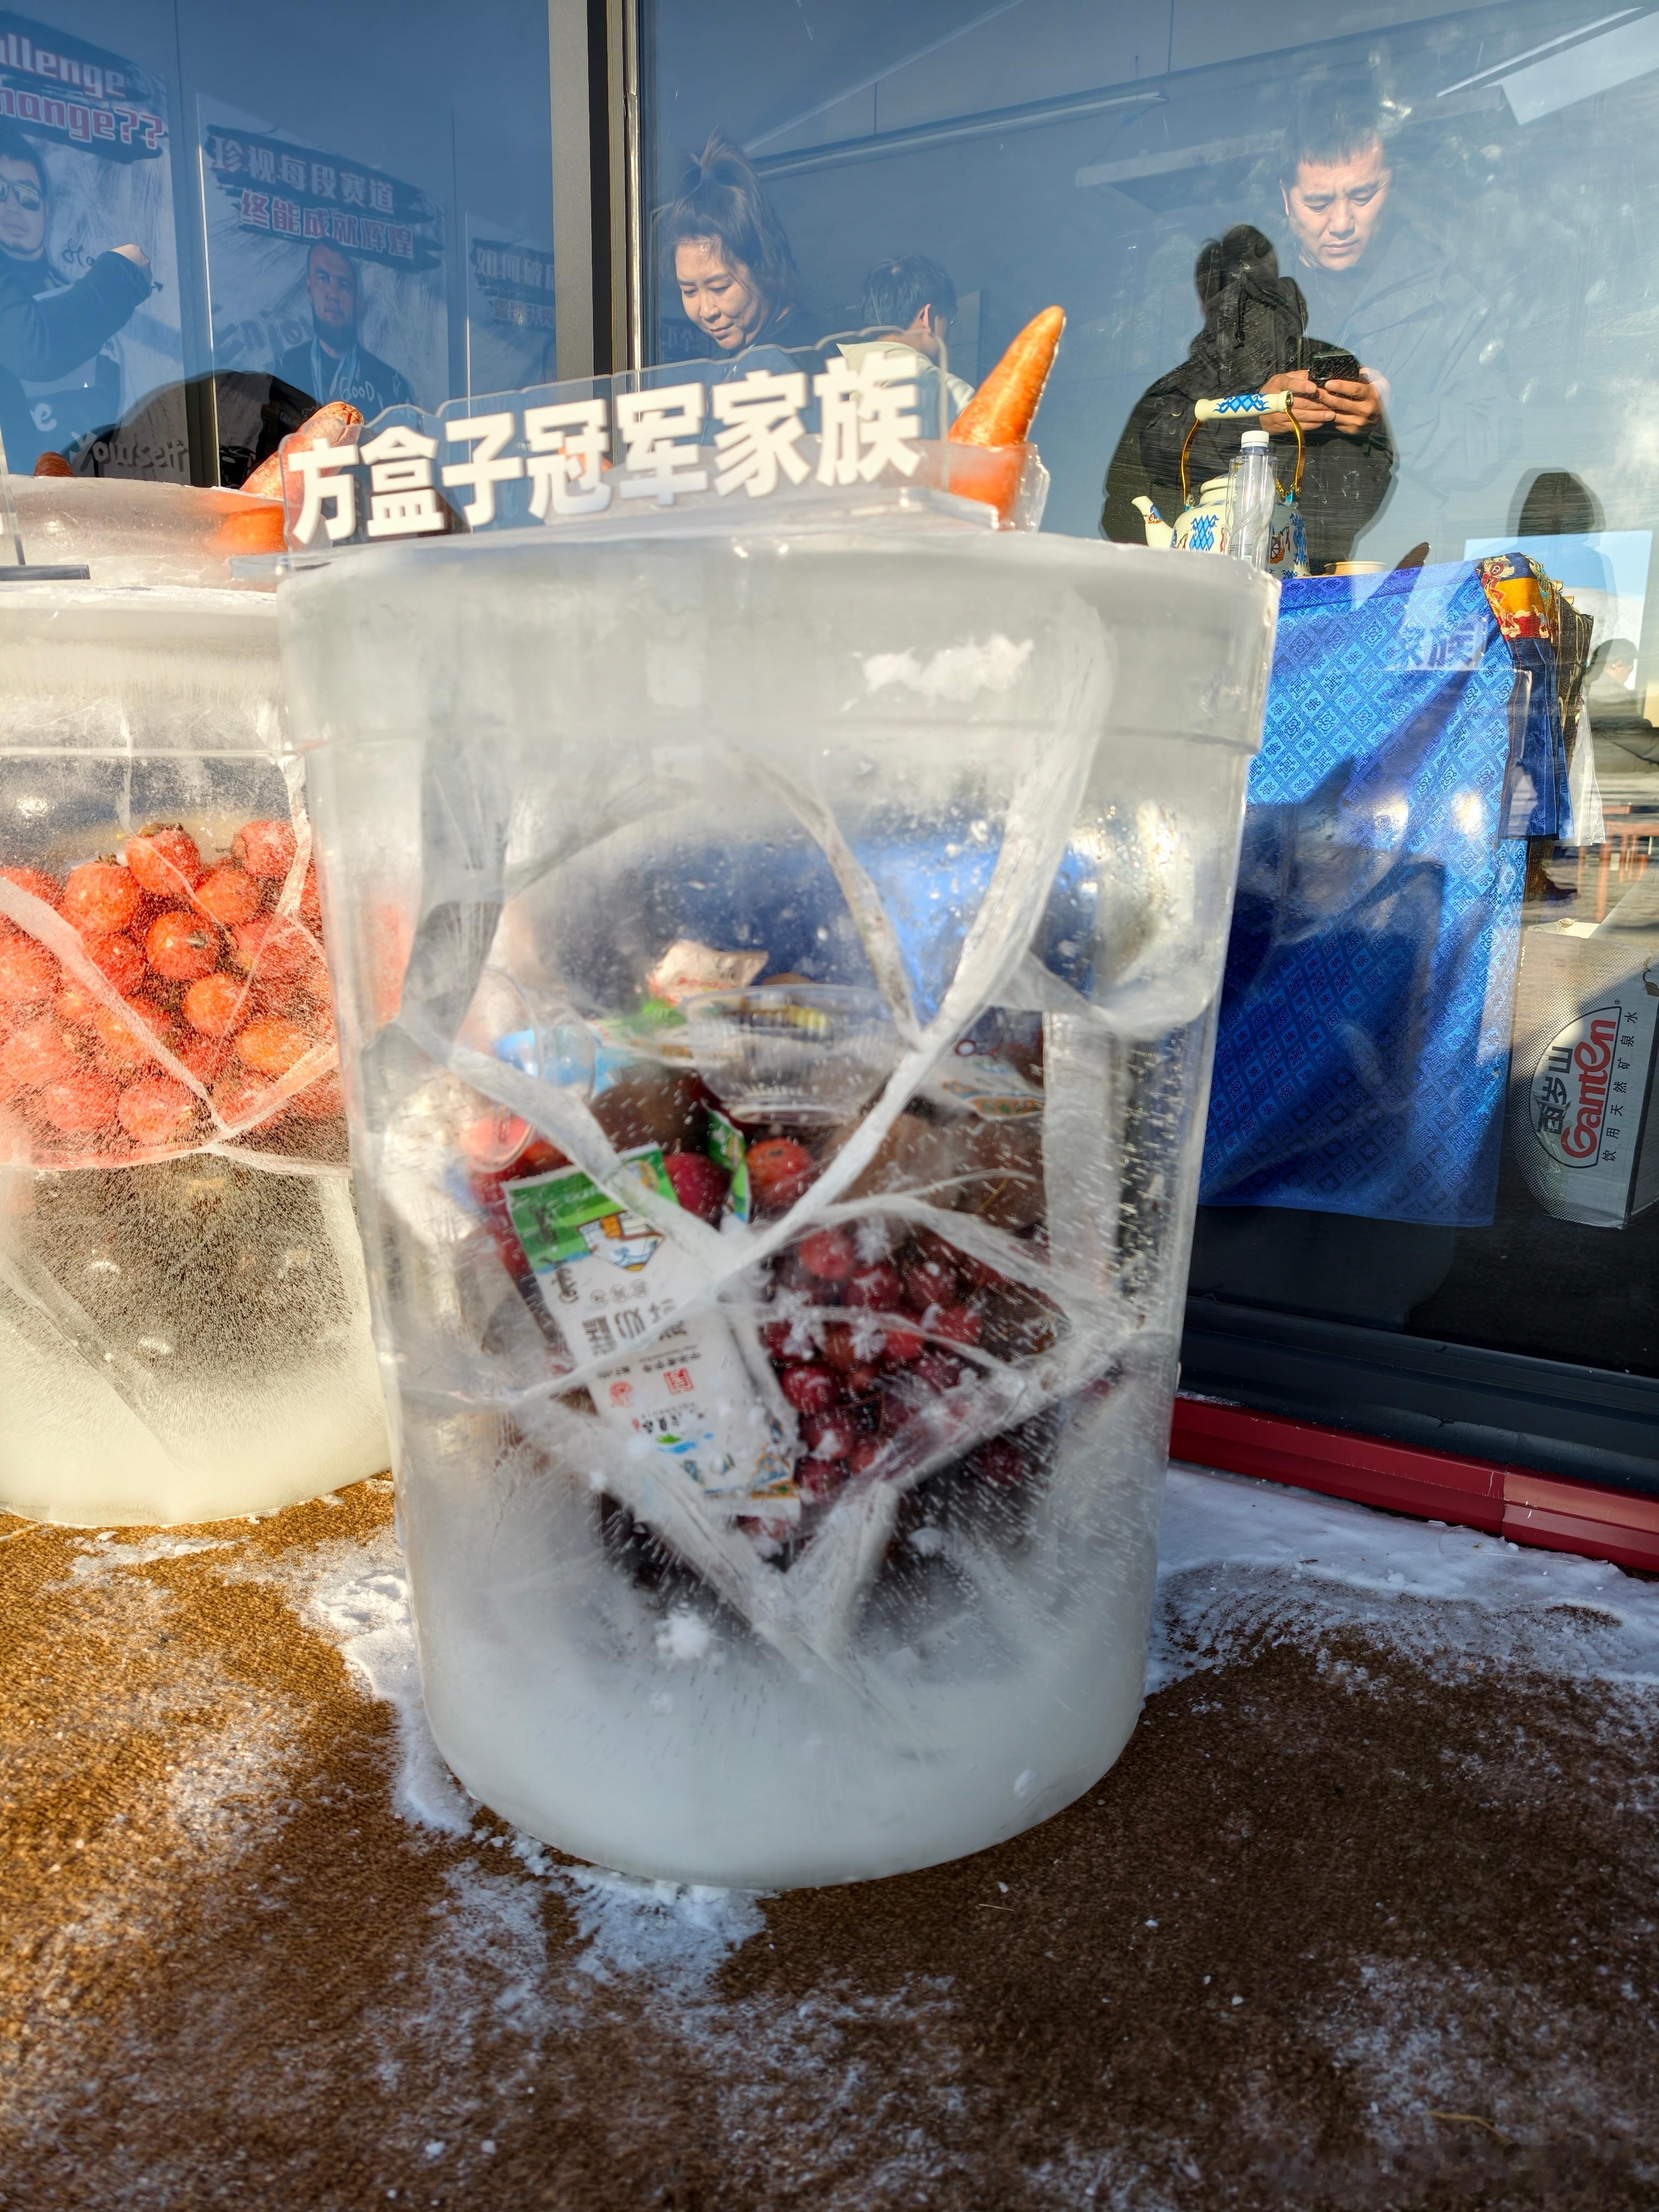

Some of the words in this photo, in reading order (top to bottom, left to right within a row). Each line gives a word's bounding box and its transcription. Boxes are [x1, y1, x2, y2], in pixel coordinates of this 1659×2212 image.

[286, 350, 921, 544] 方盒子冠军家族
[1537, 1046, 1573, 1135] 百岁山
[1561, 1019, 1617, 1158] Ganten
[1601, 1011, 1638, 1162] 饮用天然矿泉水
